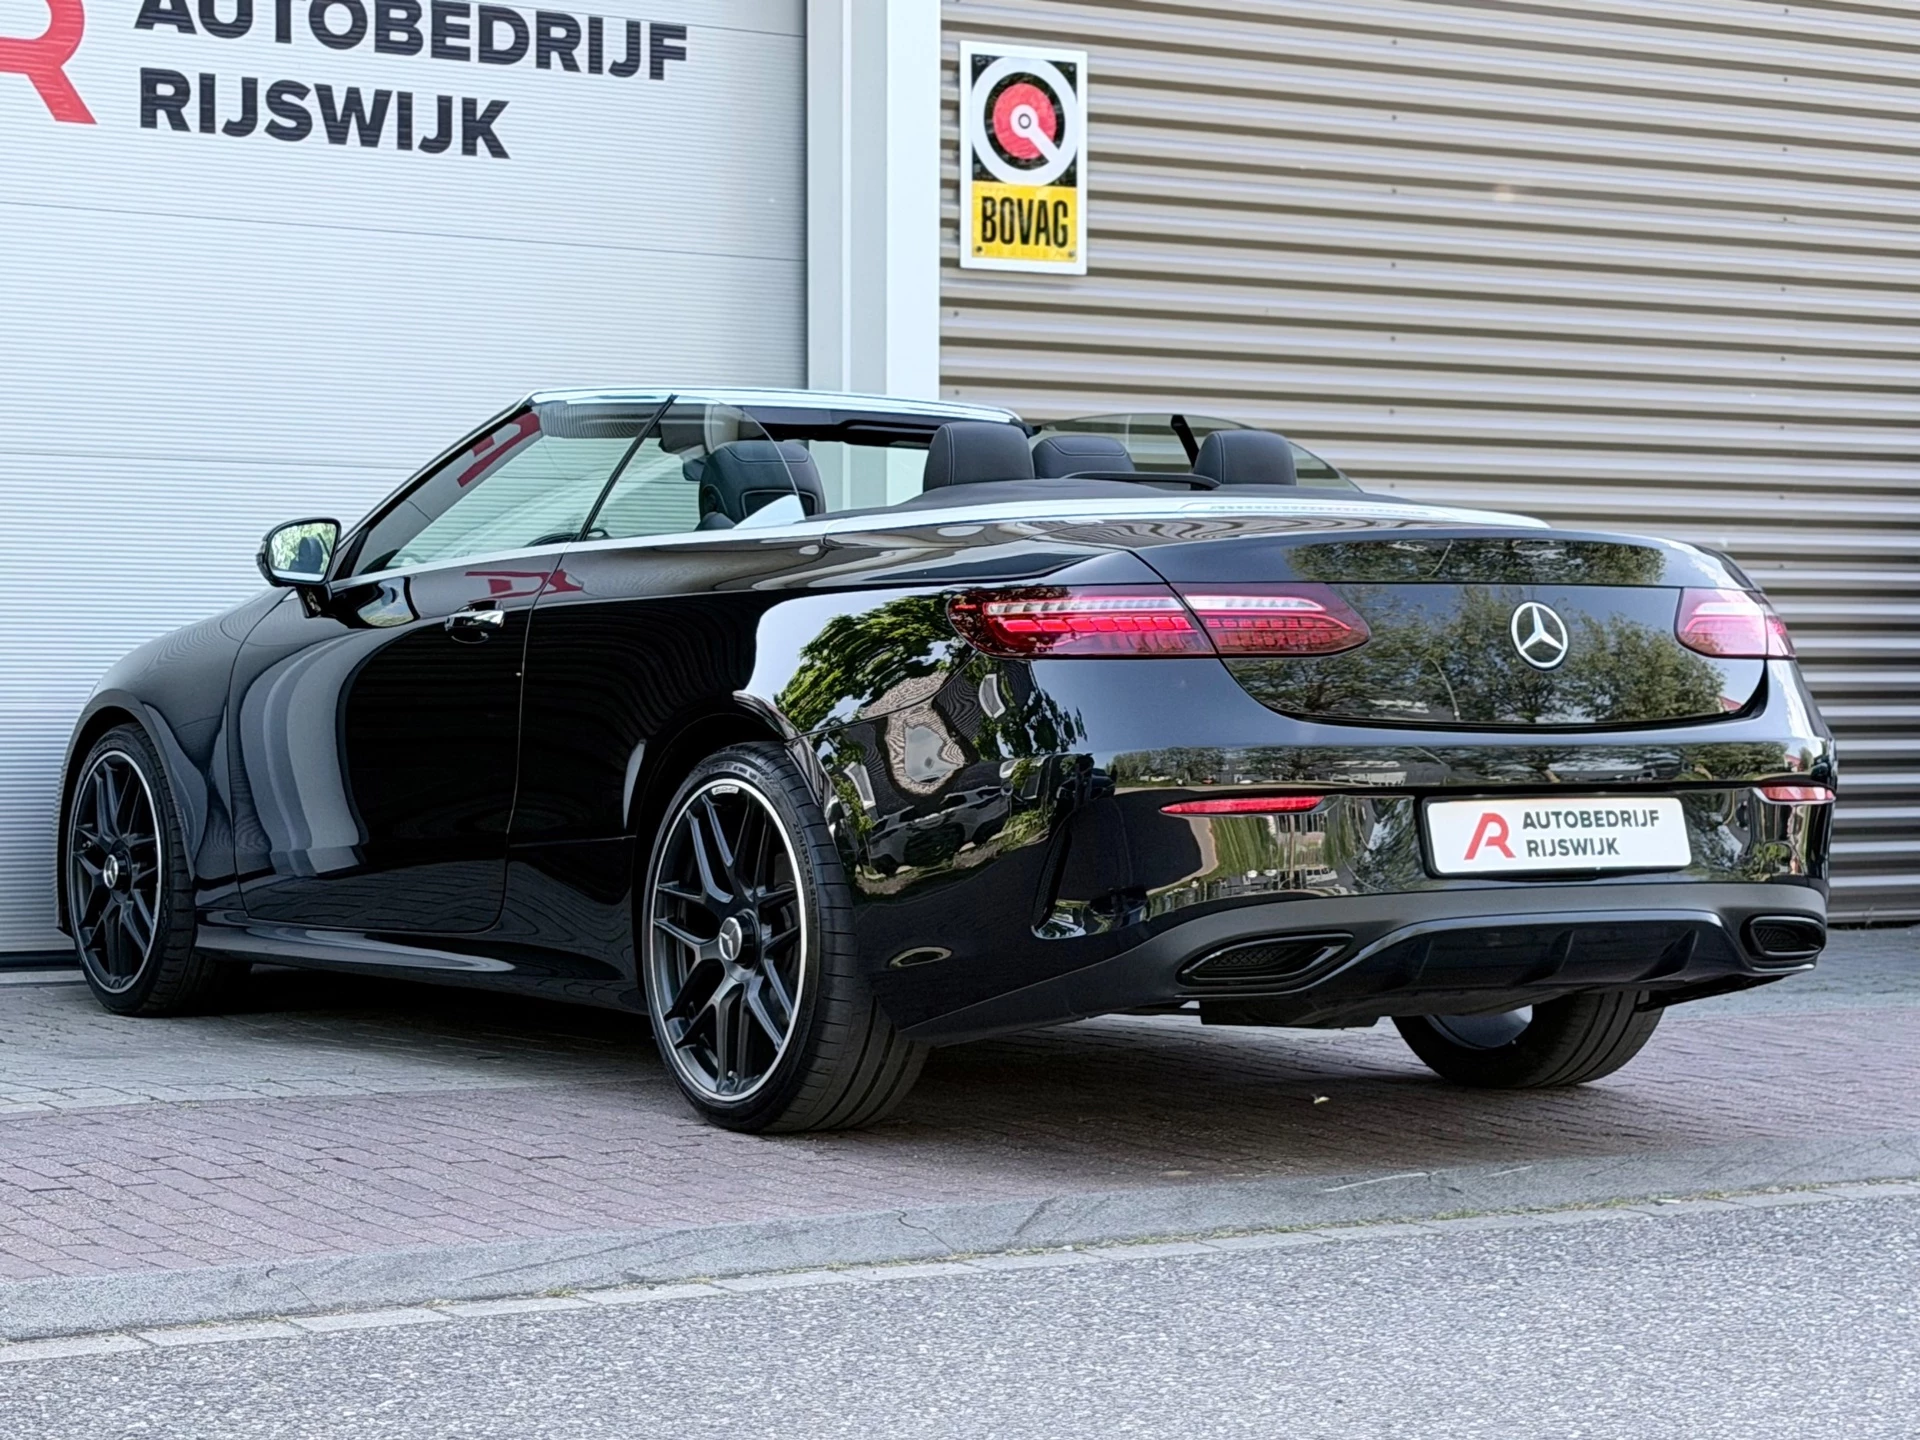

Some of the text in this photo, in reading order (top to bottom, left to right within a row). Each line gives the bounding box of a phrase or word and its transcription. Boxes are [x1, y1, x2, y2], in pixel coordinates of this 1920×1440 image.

[134, 0, 687, 81] AUTOBEDRIJF
[140, 67, 511, 159] RIJSWIJK
[981, 196, 1068, 248] BOVAG
[1522, 809, 1660, 830] AUTOBEDRIJF
[1526, 837, 1620, 857] RIJSWIJK
